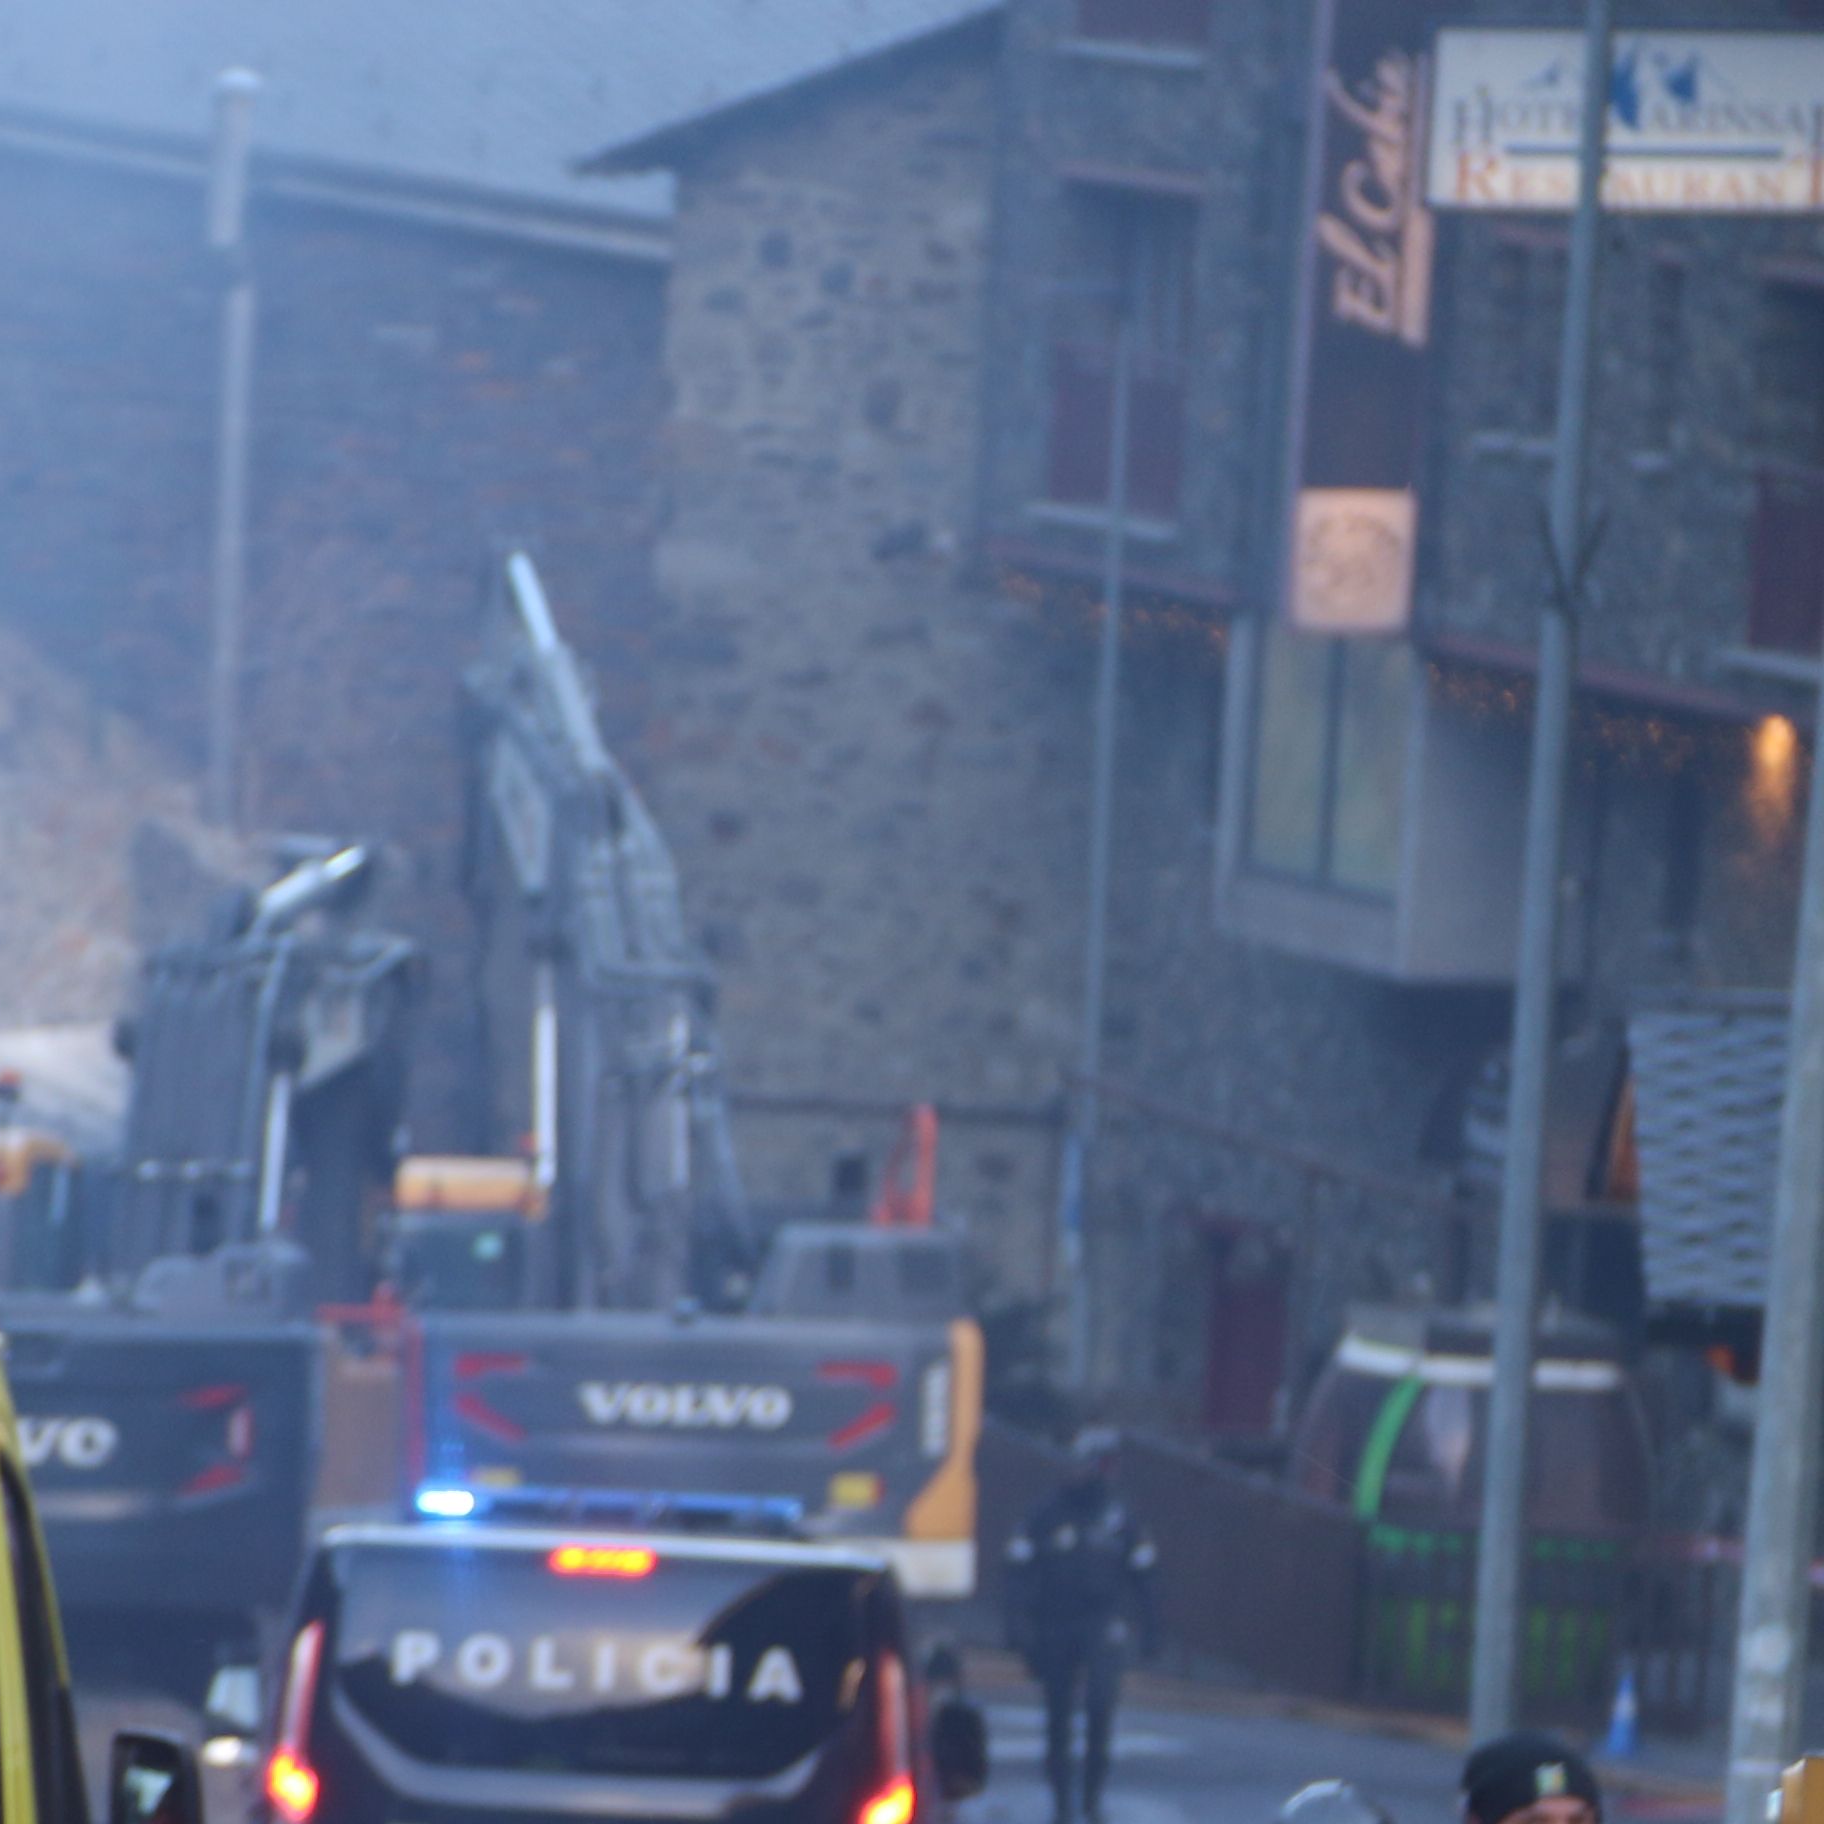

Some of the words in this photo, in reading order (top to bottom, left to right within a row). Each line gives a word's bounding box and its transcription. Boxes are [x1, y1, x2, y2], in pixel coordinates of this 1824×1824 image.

[1453, 86, 1586, 144] HOTE
[1455, 150, 1824, 204] RESAURANT
[580, 1380, 794, 1431] VOLVO
[16, 1415, 120, 1469] VO
[389, 1629, 803, 1704] POLICIA
